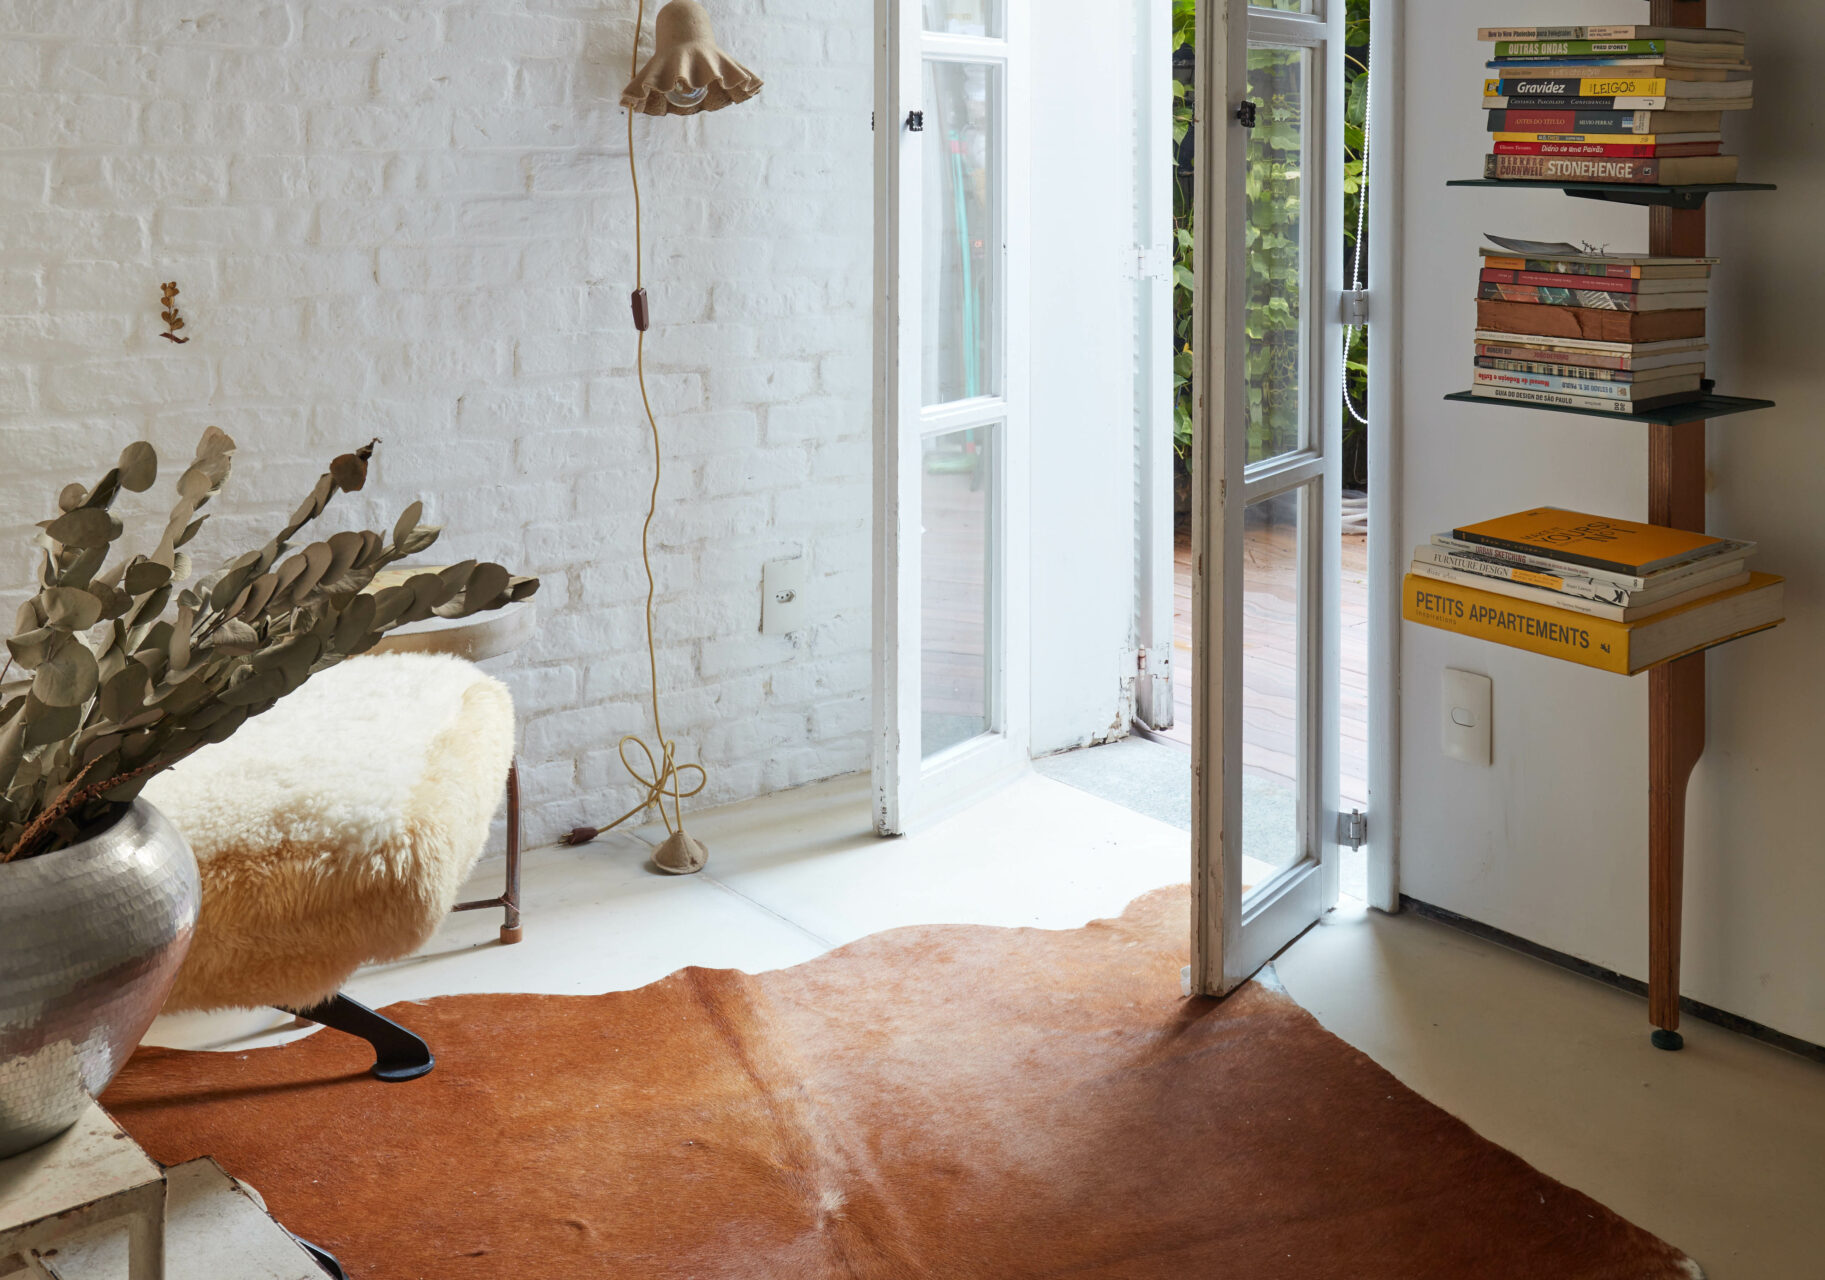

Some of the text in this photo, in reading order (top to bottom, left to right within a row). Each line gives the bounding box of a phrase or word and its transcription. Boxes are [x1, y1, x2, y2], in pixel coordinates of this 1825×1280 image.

[1513, 29, 1535, 38] Photoshop
[1509, 42, 1568, 55] OUTRAS ONDAS
[1517, 81, 1635, 95] Gravidez LEIGOS
[1541, 144, 1559, 152] Diário
[1582, 145, 1603, 153] Paixão
[1501, 157, 1543, 166] BERNARD
[1501, 166, 1542, 177] CORNWELL
[1548, 160, 1633, 177] STONEHENGE
[1478, 373, 1492, 381] Estilo
[1498, 374, 1520, 384] Redação
[1529, 379, 1549, 387] Manual
[1562, 381, 1577, 389] PAULO
[1590, 385, 1608, 393] ESTADO
[1495, 389, 1507, 397] GUIA
[1516, 392, 1534, 400] DESIGN
[1544, 394, 1554, 402] SÃO
[1555, 395, 1572, 404] PAULO
[1475, 545, 1526, 563] URBAN SKETCHING
[1434, 553, 1508, 577] FURNITURE DESIGN
[1415, 591, 1589, 648] PETITS APPARTEMENTS
